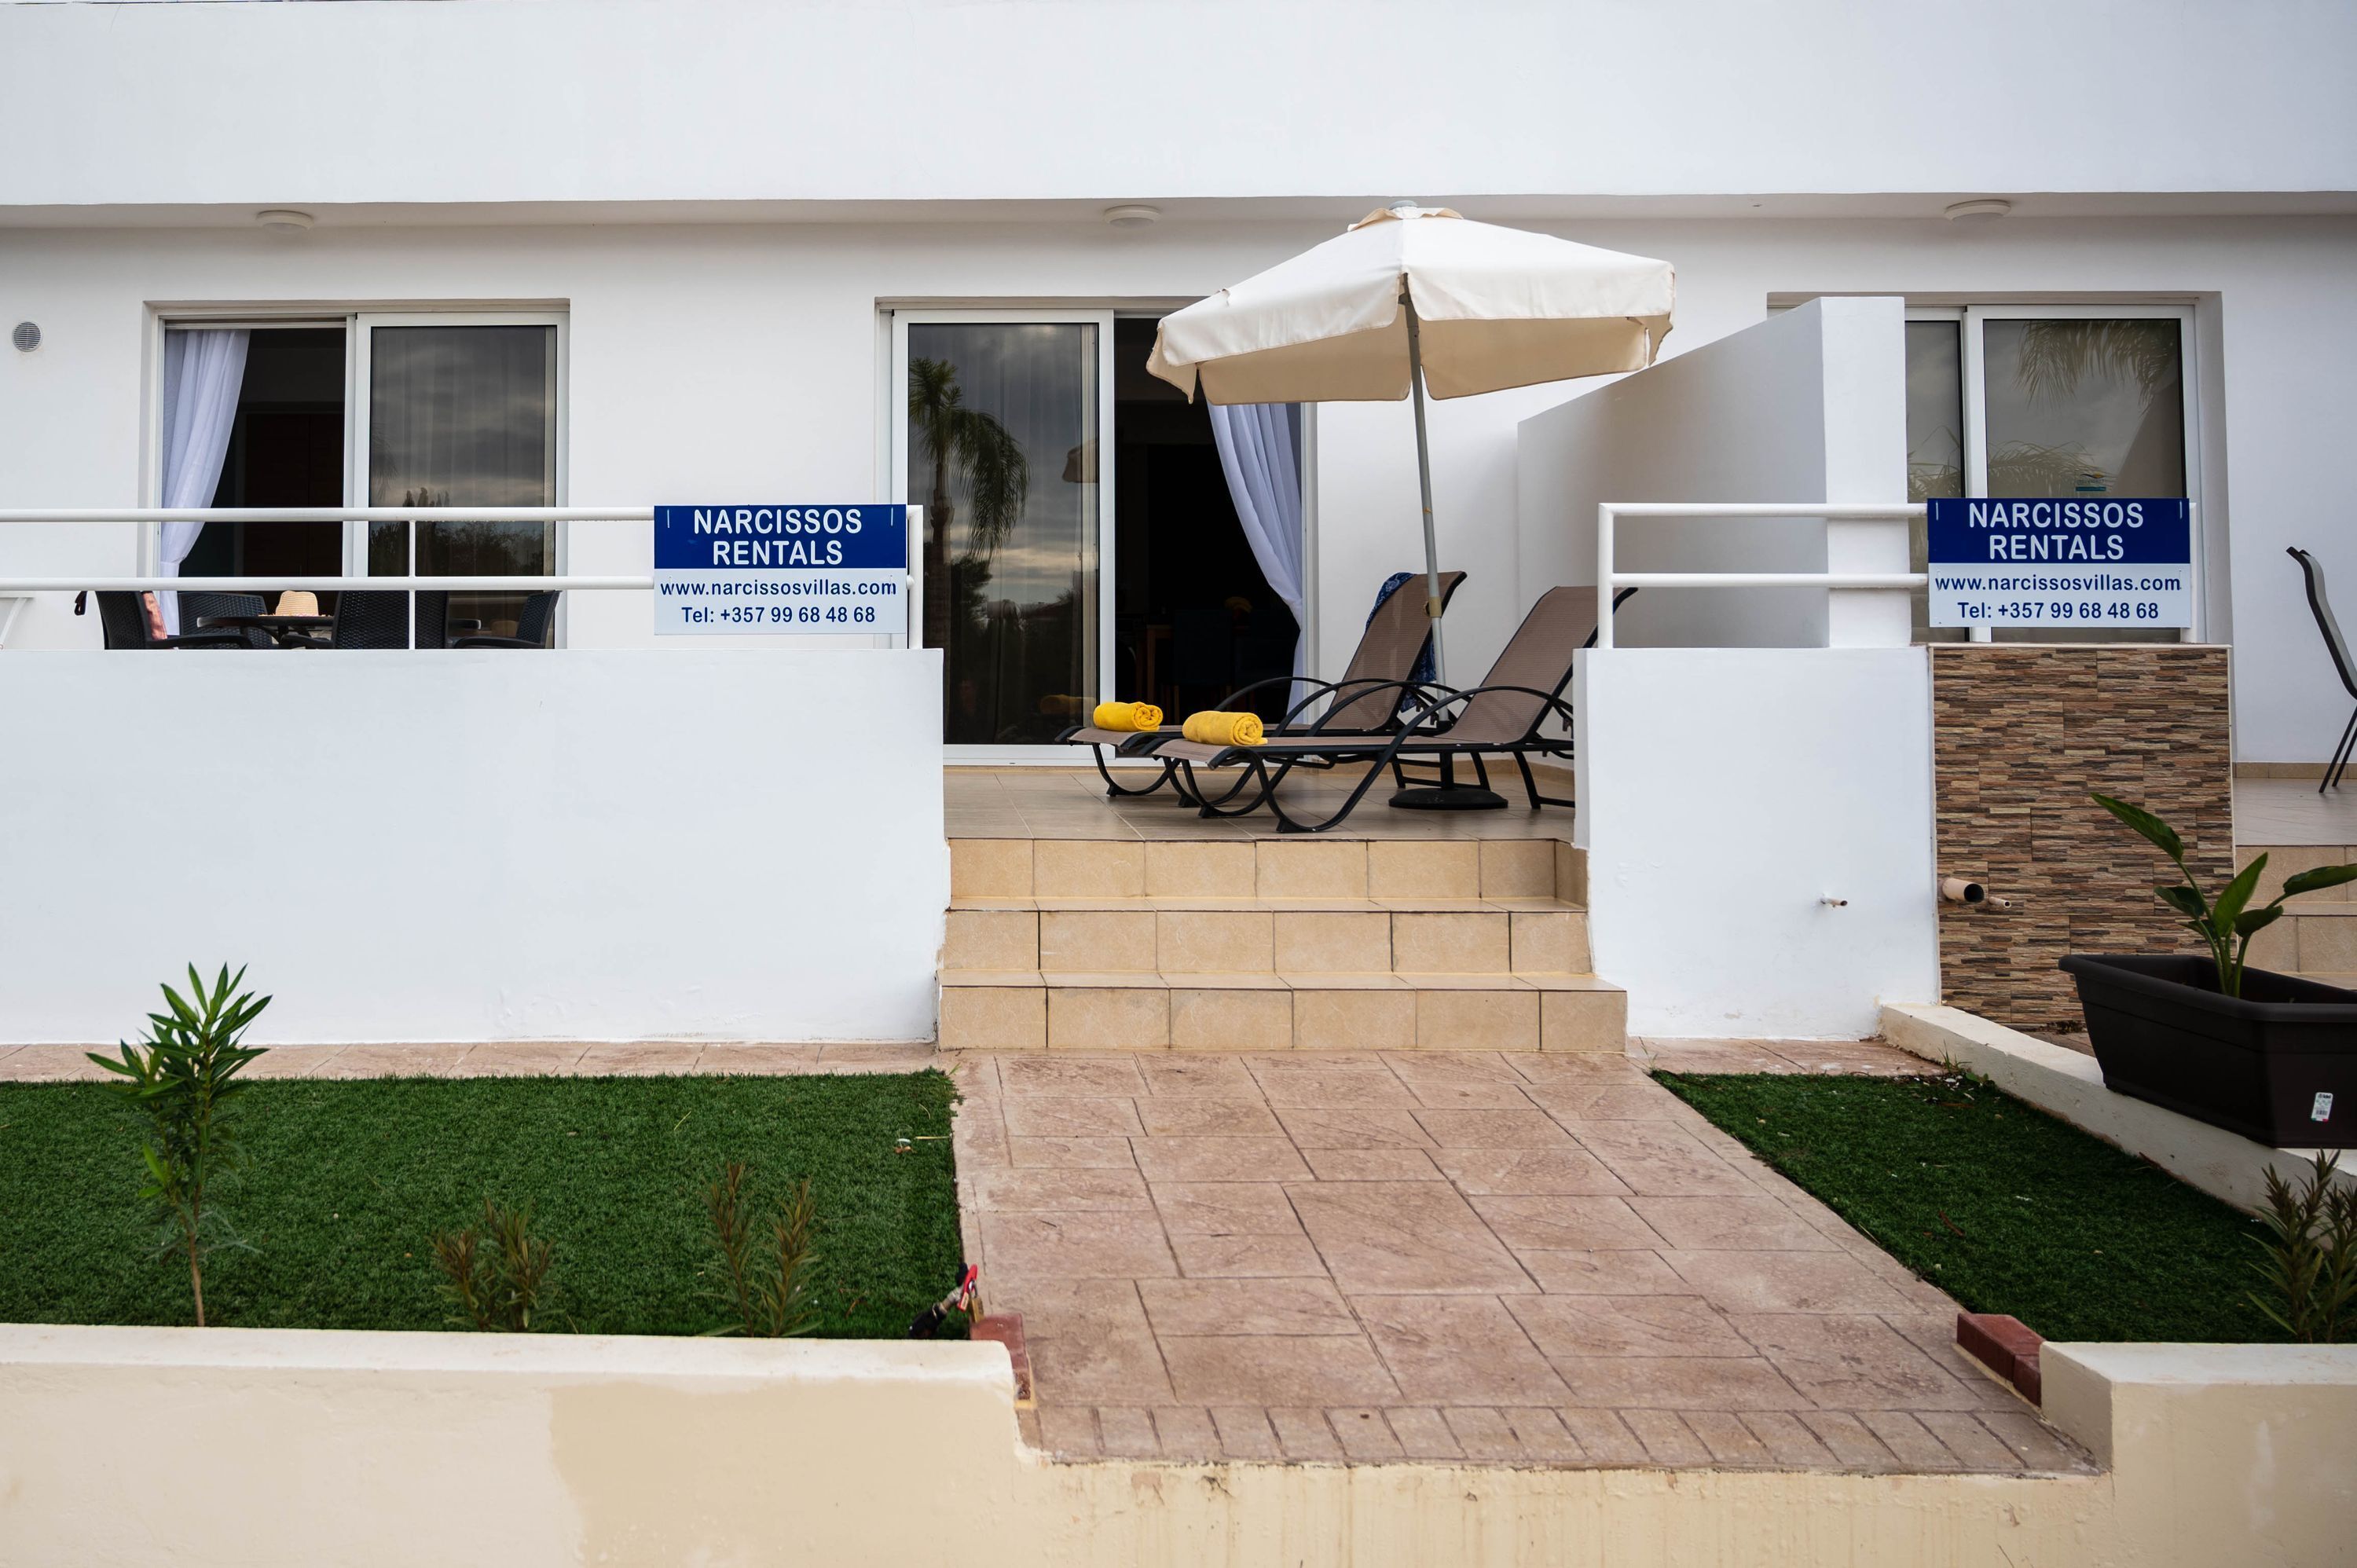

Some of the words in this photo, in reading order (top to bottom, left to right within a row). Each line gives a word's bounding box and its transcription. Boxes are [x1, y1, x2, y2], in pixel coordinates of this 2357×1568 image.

[695, 509, 861, 534] NARCISSOS
[1969, 503, 2144, 528] NARCISSOS
[713, 540, 842, 566] RENTALS
[1989, 535, 2124, 560] RENTALS
[660, 579, 896, 595] www.narcissosvillas.com
[1935, 574, 2181, 591] www.narcissosvillas.com
[681, 606, 714, 623] Tel:
[720, 606, 764, 623] +357
[771, 606, 793, 623] 99
[798, 606, 820, 623] 68
[826, 606, 848, 623] 48
[853, 606, 875, 623] 68
[1958, 602, 1992, 619] Tel:
[1998, 602, 2044, 619] +357
[2051, 602, 2073, 619] 99
[2079, 602, 2102, 619] 68
[2107, 602, 2130, 619] 48
[2136, 602, 2159, 619] 68
